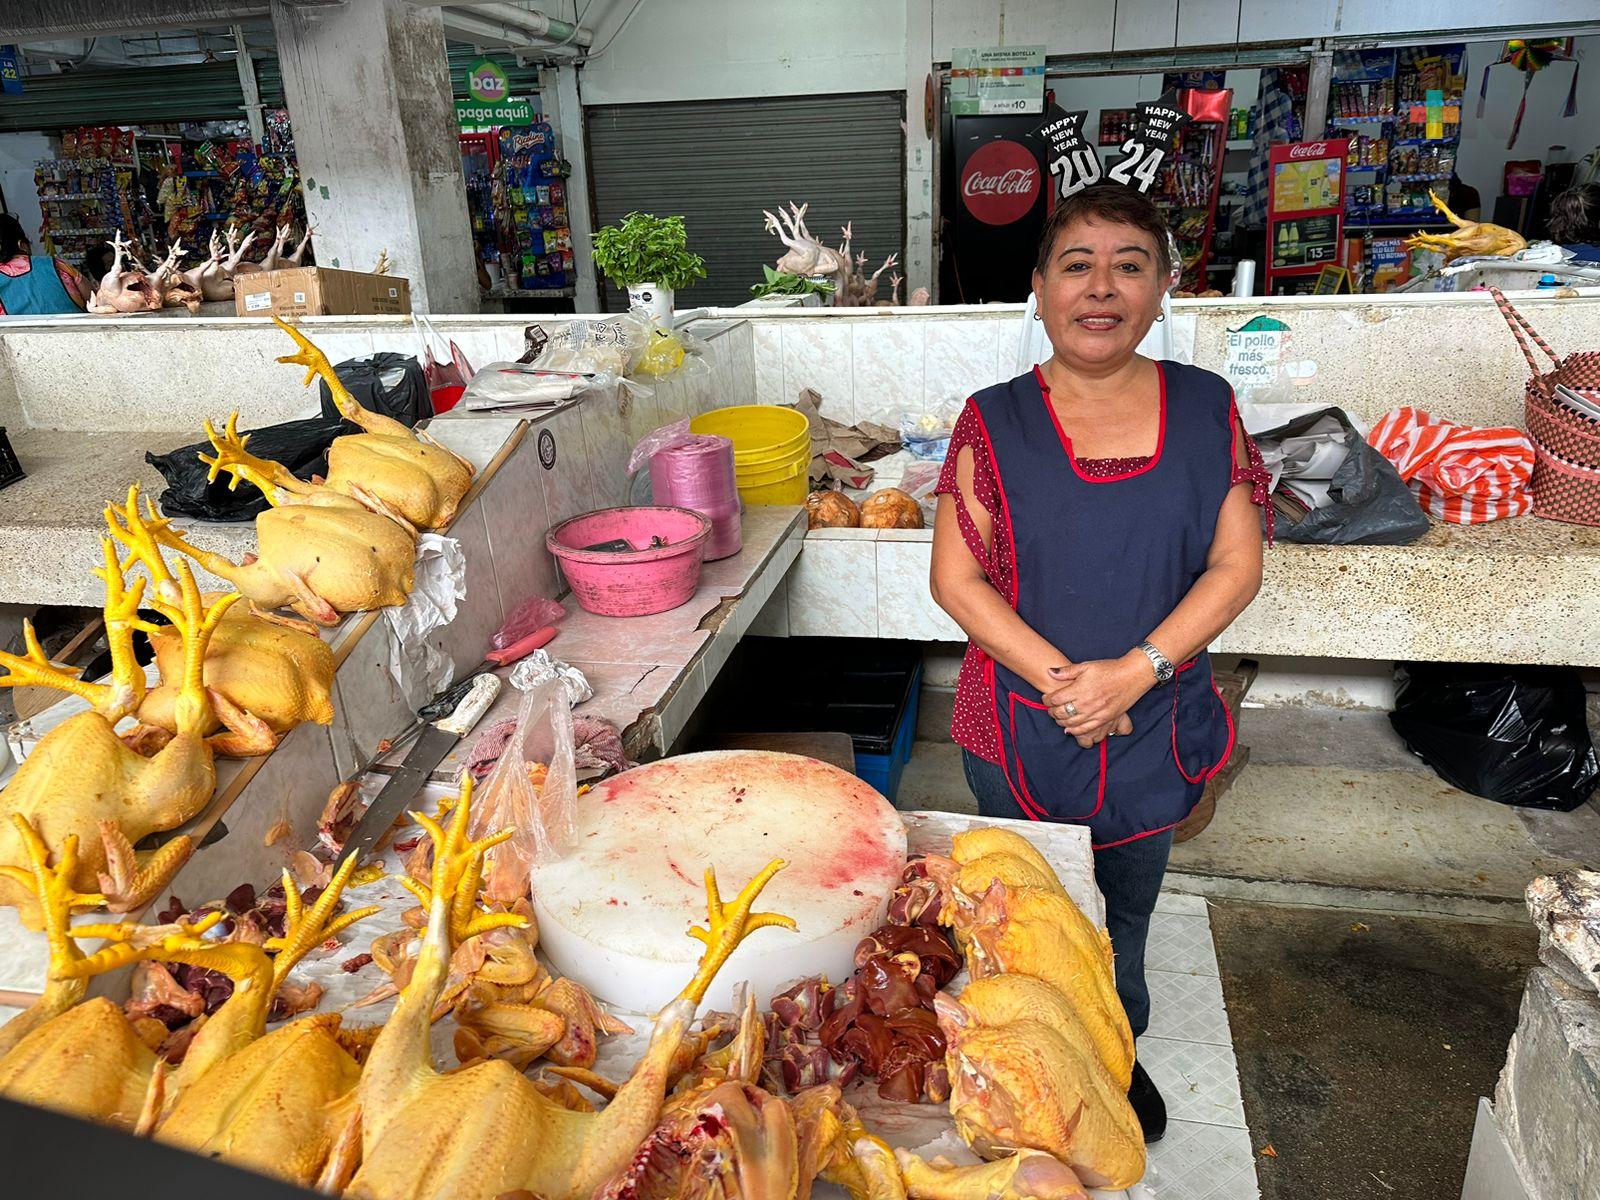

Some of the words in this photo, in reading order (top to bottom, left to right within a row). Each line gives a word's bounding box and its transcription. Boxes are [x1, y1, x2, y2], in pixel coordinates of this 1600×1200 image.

[4, 67, 17, 79] 22
[469, 72, 505, 90] baz
[457, 108, 493, 122] paga
[495, 106, 530, 121] aquí!
[1145, 106, 1183, 122] HAPPY
[1041, 115, 1078, 137] HAPPY
[1148, 118, 1173, 130] NEW
[1051, 127, 1074, 143] NEW
[1144, 128, 1169, 142] YEAR
[1053, 137, 1079, 153] YEAR
[1290, 143, 1327, 158] Coca-Cola
[1050, 146, 1100, 199] 20
[1108, 138, 1165, 194] 24
[965, 169, 1037, 196] Coca-Cola
[1230, 334, 1241, 346] El
[1245, 334, 1274, 348] pollo
[1238, 348, 1264, 362] más
[1229, 364, 1270, 376] fresco.
